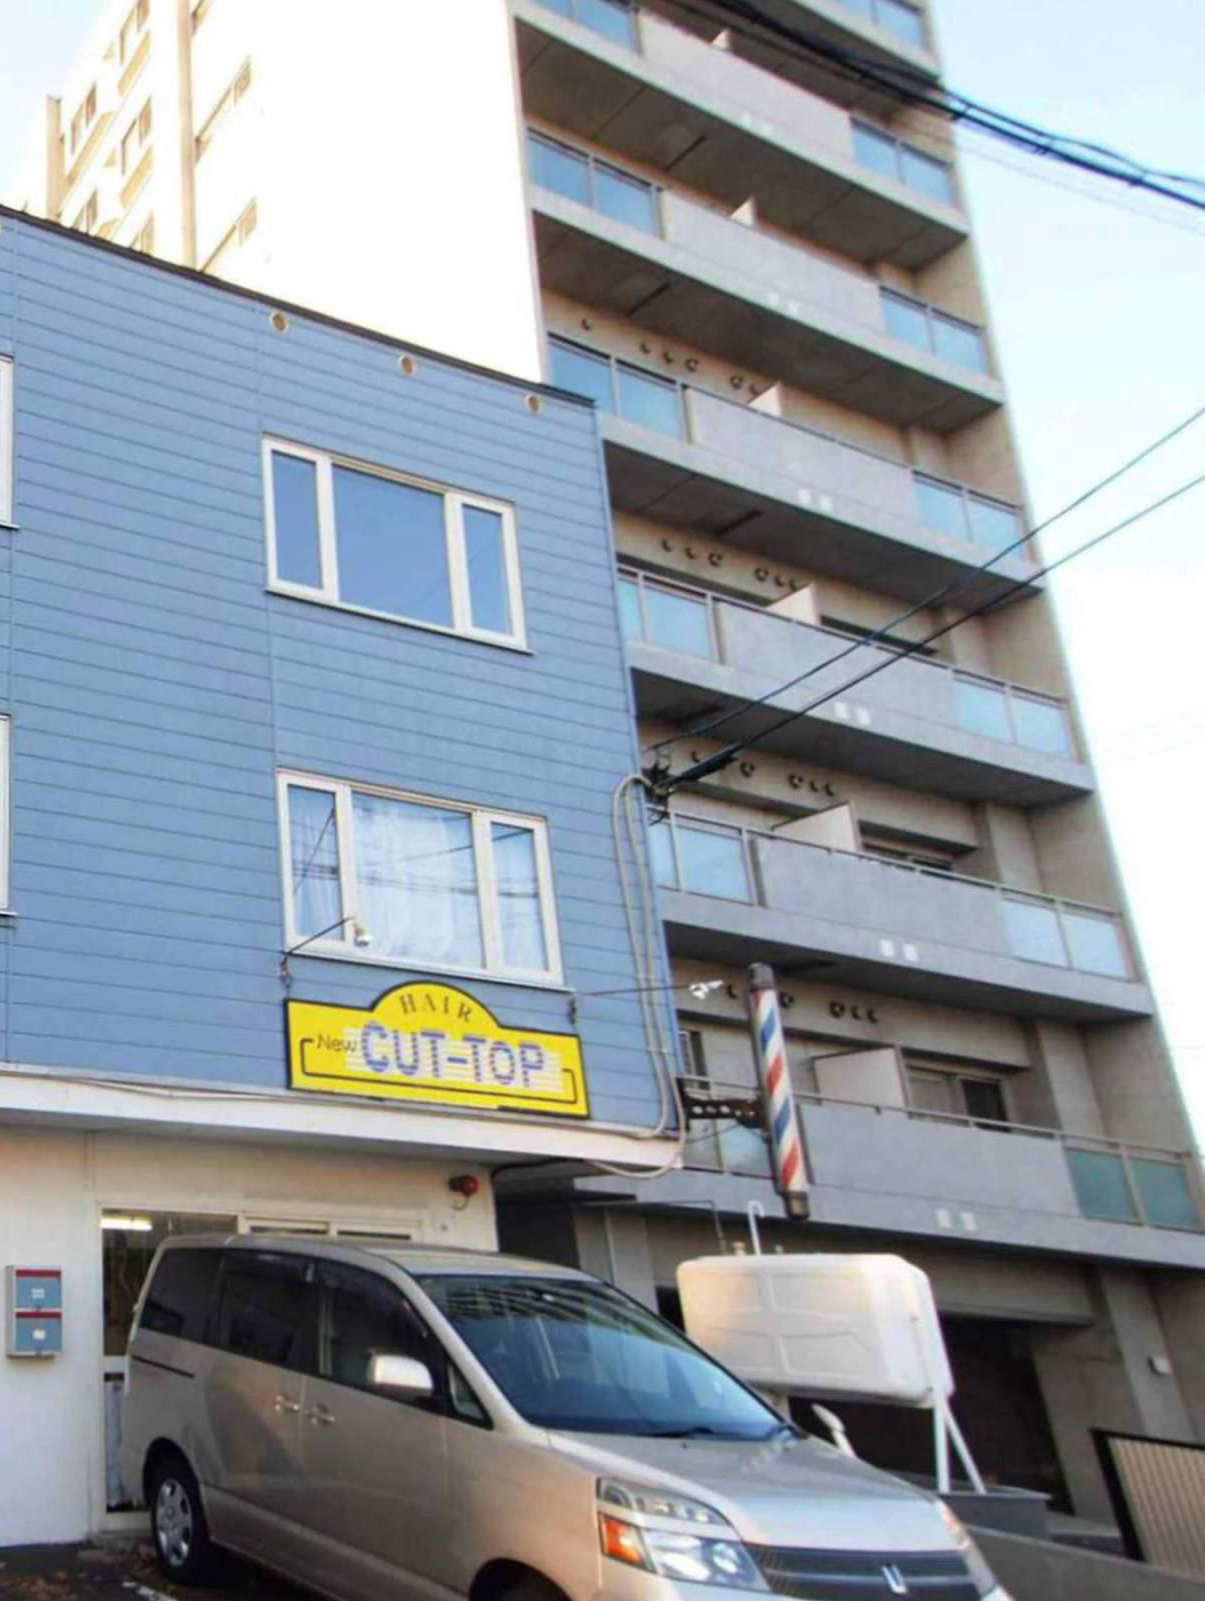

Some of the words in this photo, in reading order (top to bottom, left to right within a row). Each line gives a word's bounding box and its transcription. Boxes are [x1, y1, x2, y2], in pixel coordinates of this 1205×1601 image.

[399, 992, 473, 1024] HAIR
[316, 1033, 358, 1053] New
[361, 1021, 544, 1088] CUT-TOP
